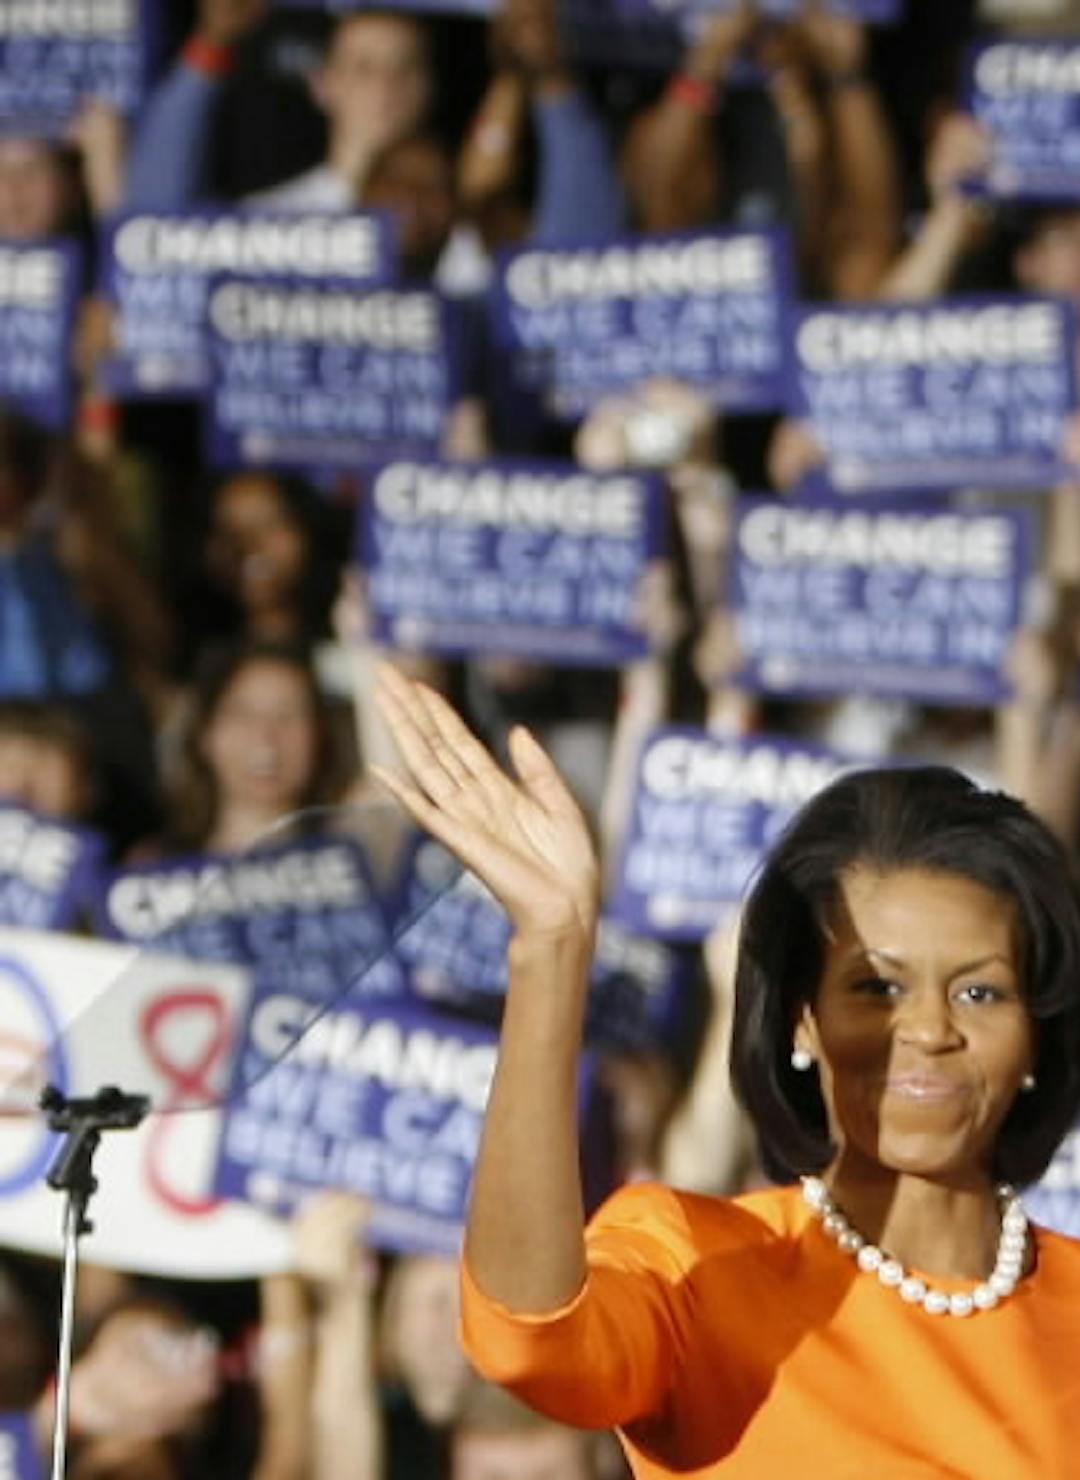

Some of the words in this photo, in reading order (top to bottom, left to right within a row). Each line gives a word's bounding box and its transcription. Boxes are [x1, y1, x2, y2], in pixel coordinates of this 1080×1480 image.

[115, 214, 382, 280] CHANGE
[506, 234, 770, 310] CHANGE
[209, 282, 438, 352] CHANGE
[796, 303, 1060, 374] CHANGE
[373, 462, 646, 538] CHANGE
[739, 504, 1018, 574] CHANGE
[863, 568, 1018, 618] CAN
[645, 736, 850, 806] CHAN
[108, 846, 364, 938] CHANGE
[250, 993, 500, 1102] CHANG
